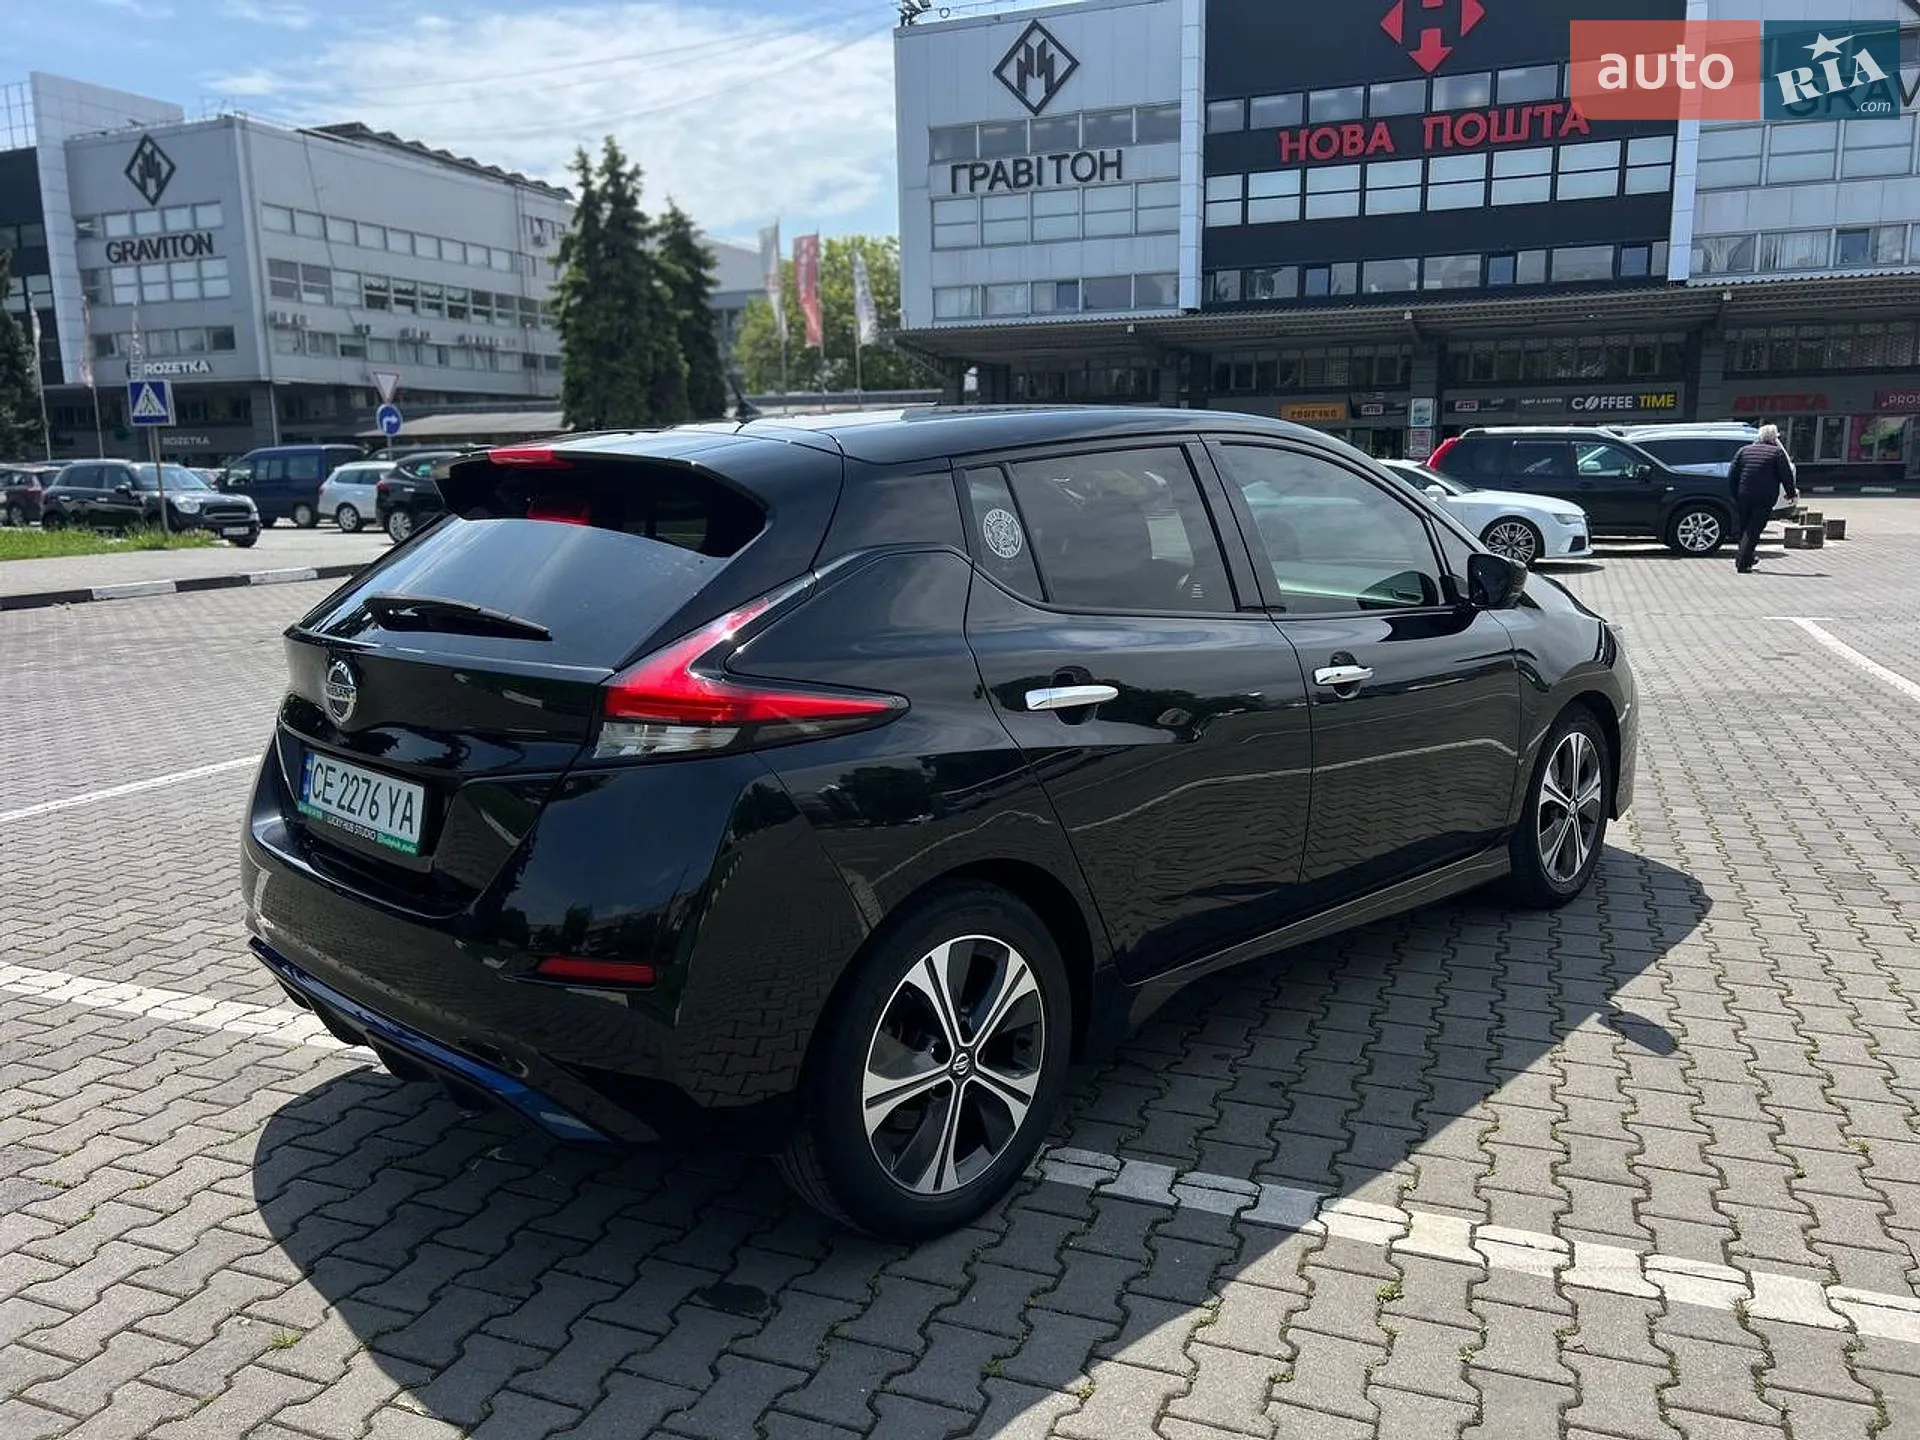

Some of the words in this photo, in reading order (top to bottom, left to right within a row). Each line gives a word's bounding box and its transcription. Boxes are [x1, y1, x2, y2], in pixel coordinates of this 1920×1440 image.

[1280, 121, 1396, 163] НОВА
[1422, 103, 1591, 149] ПОШТА
[951, 149, 1123, 194] ГРАВІТОН
[106, 231, 214, 263] GRAVITON
[144, 360, 211, 375] ROZETKA
[1571, 396, 1633, 410] COFFEE
[1639, 394, 1675, 408] TIME
[312, 762, 336, 805] CE
[337, 772, 382, 821] 2276
[388, 785, 414, 835] YA
